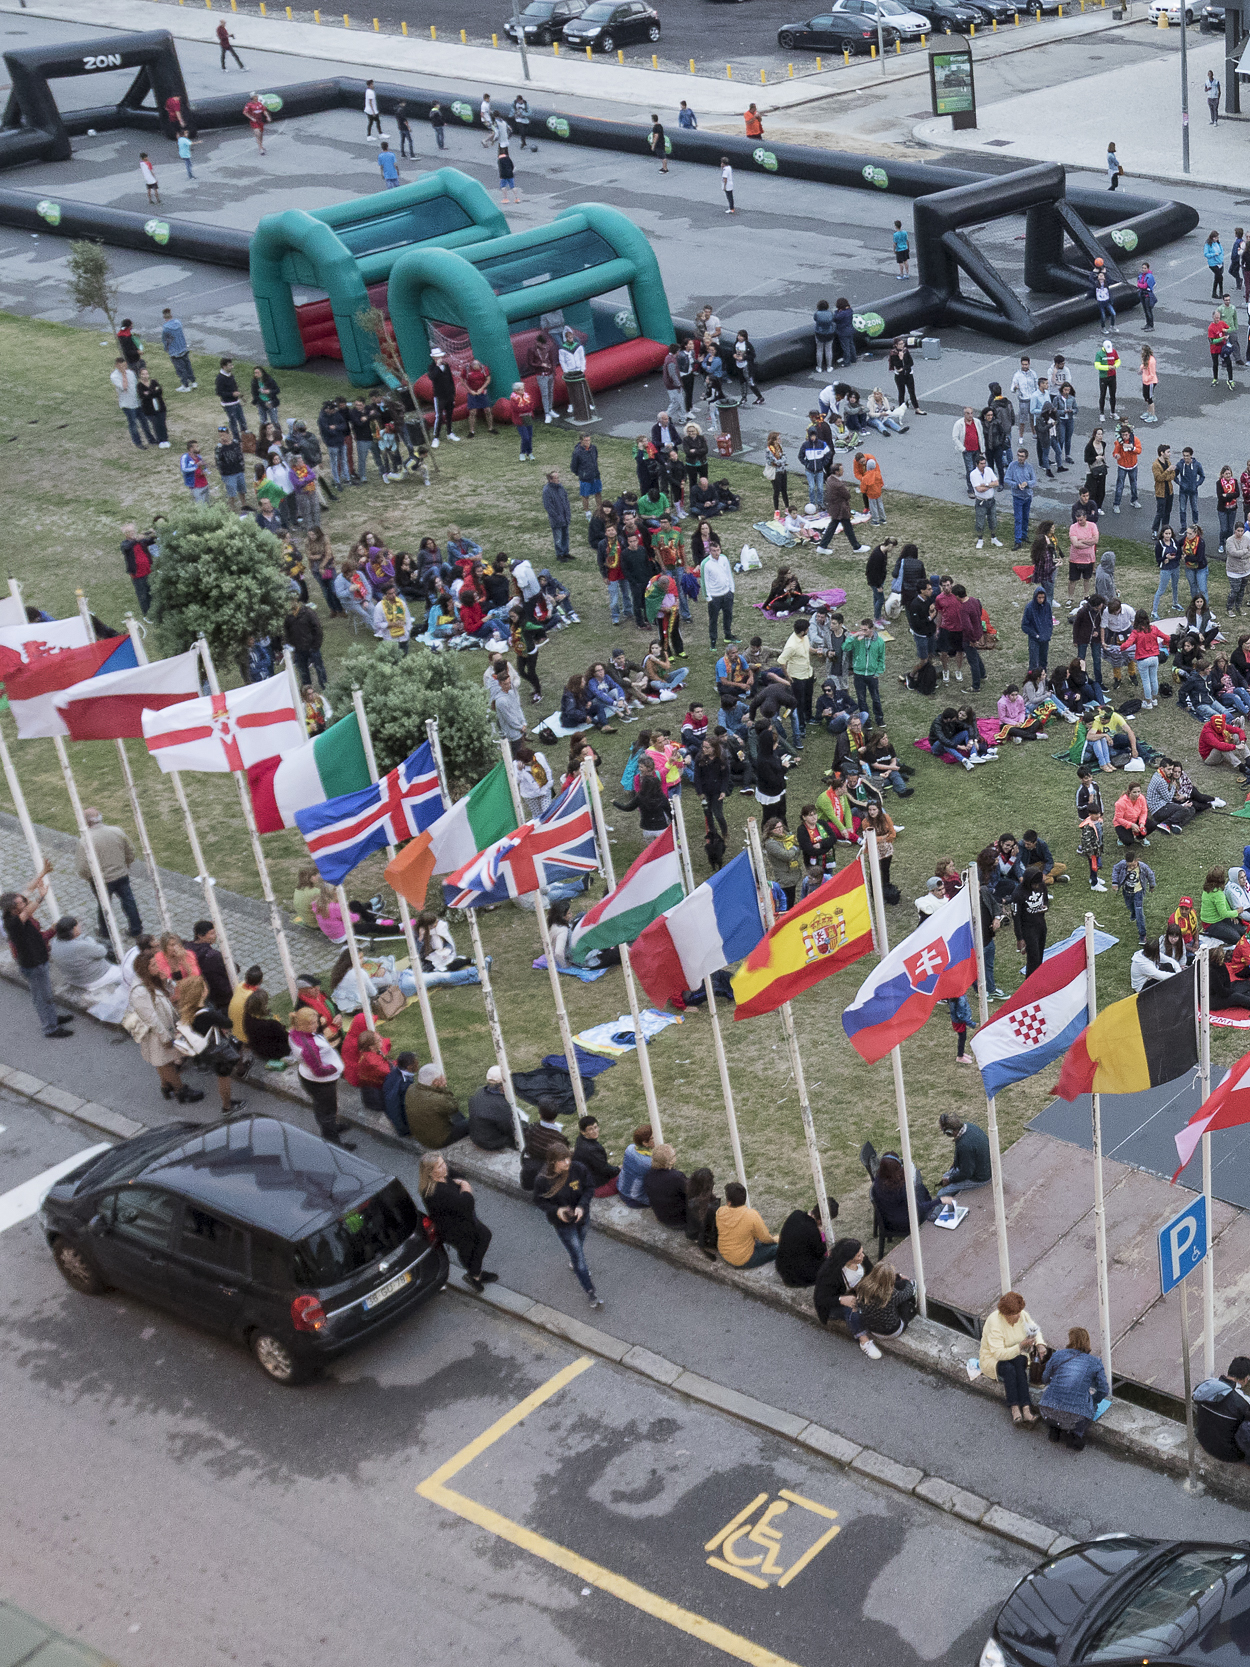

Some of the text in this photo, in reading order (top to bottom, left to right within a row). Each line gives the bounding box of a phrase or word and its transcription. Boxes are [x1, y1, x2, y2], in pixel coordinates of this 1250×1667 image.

[83, 54, 121, 69] ZON
[867, 318, 882, 327] ZON
[1170, 1216, 1197, 1280] P
